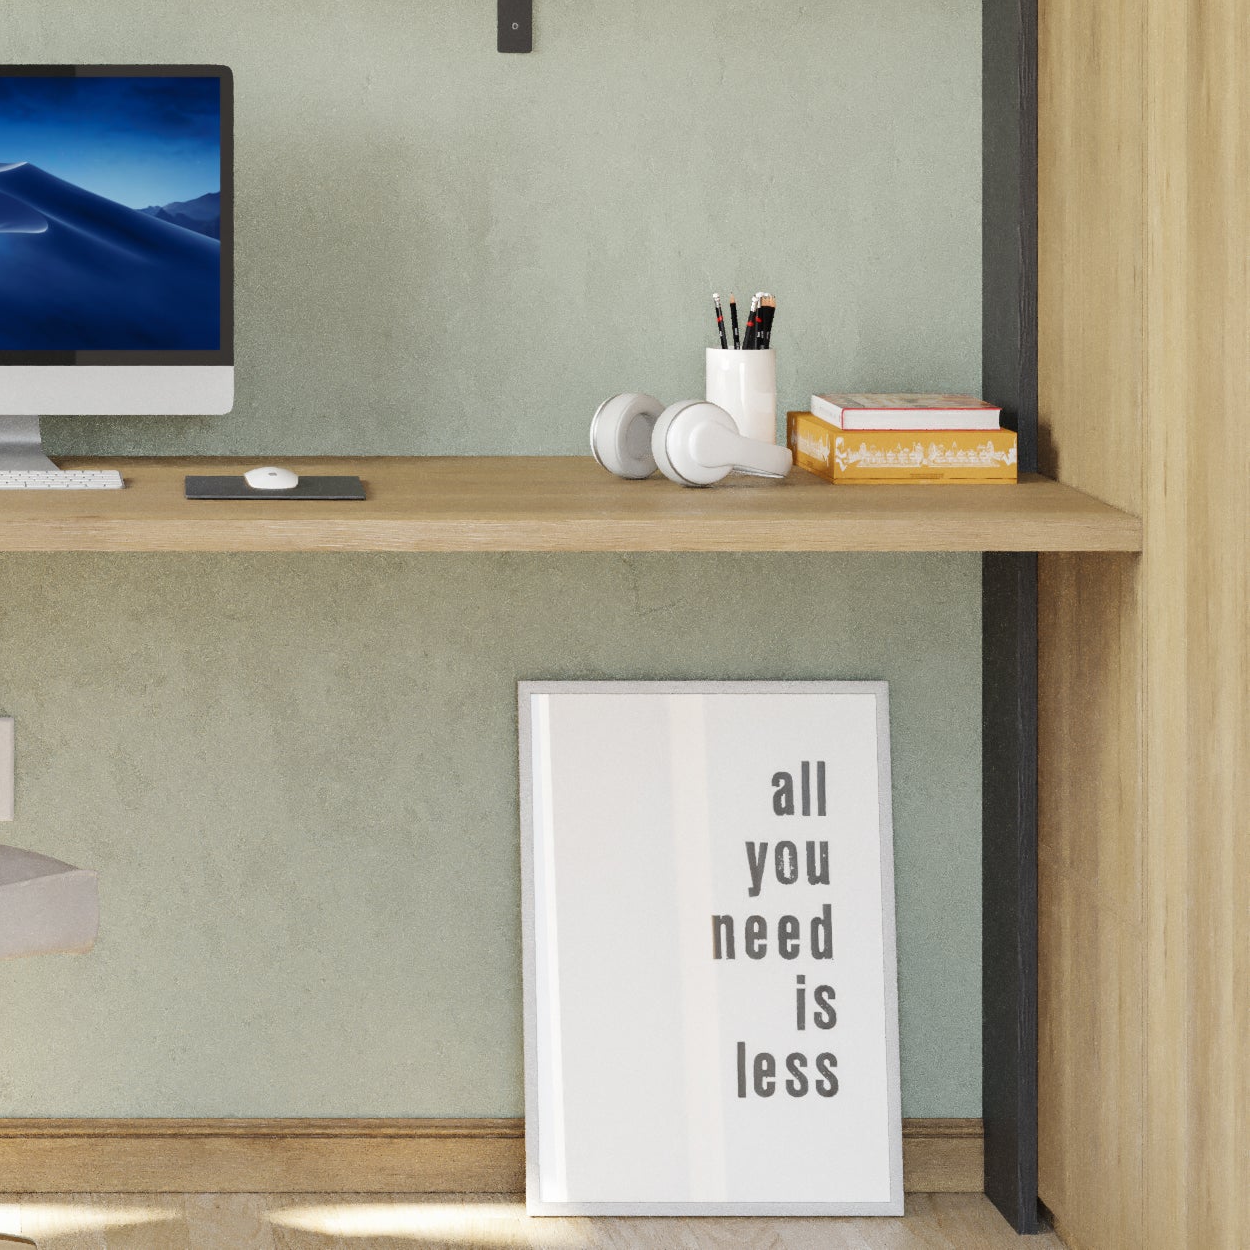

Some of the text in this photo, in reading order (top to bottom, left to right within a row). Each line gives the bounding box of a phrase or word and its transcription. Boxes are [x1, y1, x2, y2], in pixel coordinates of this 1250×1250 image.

[771, 761, 826, 816] all
[745, 840, 831, 897] you
[712, 904, 834, 960] need
[796, 975, 838, 1030] is
[736, 1041, 839, 1099] less
